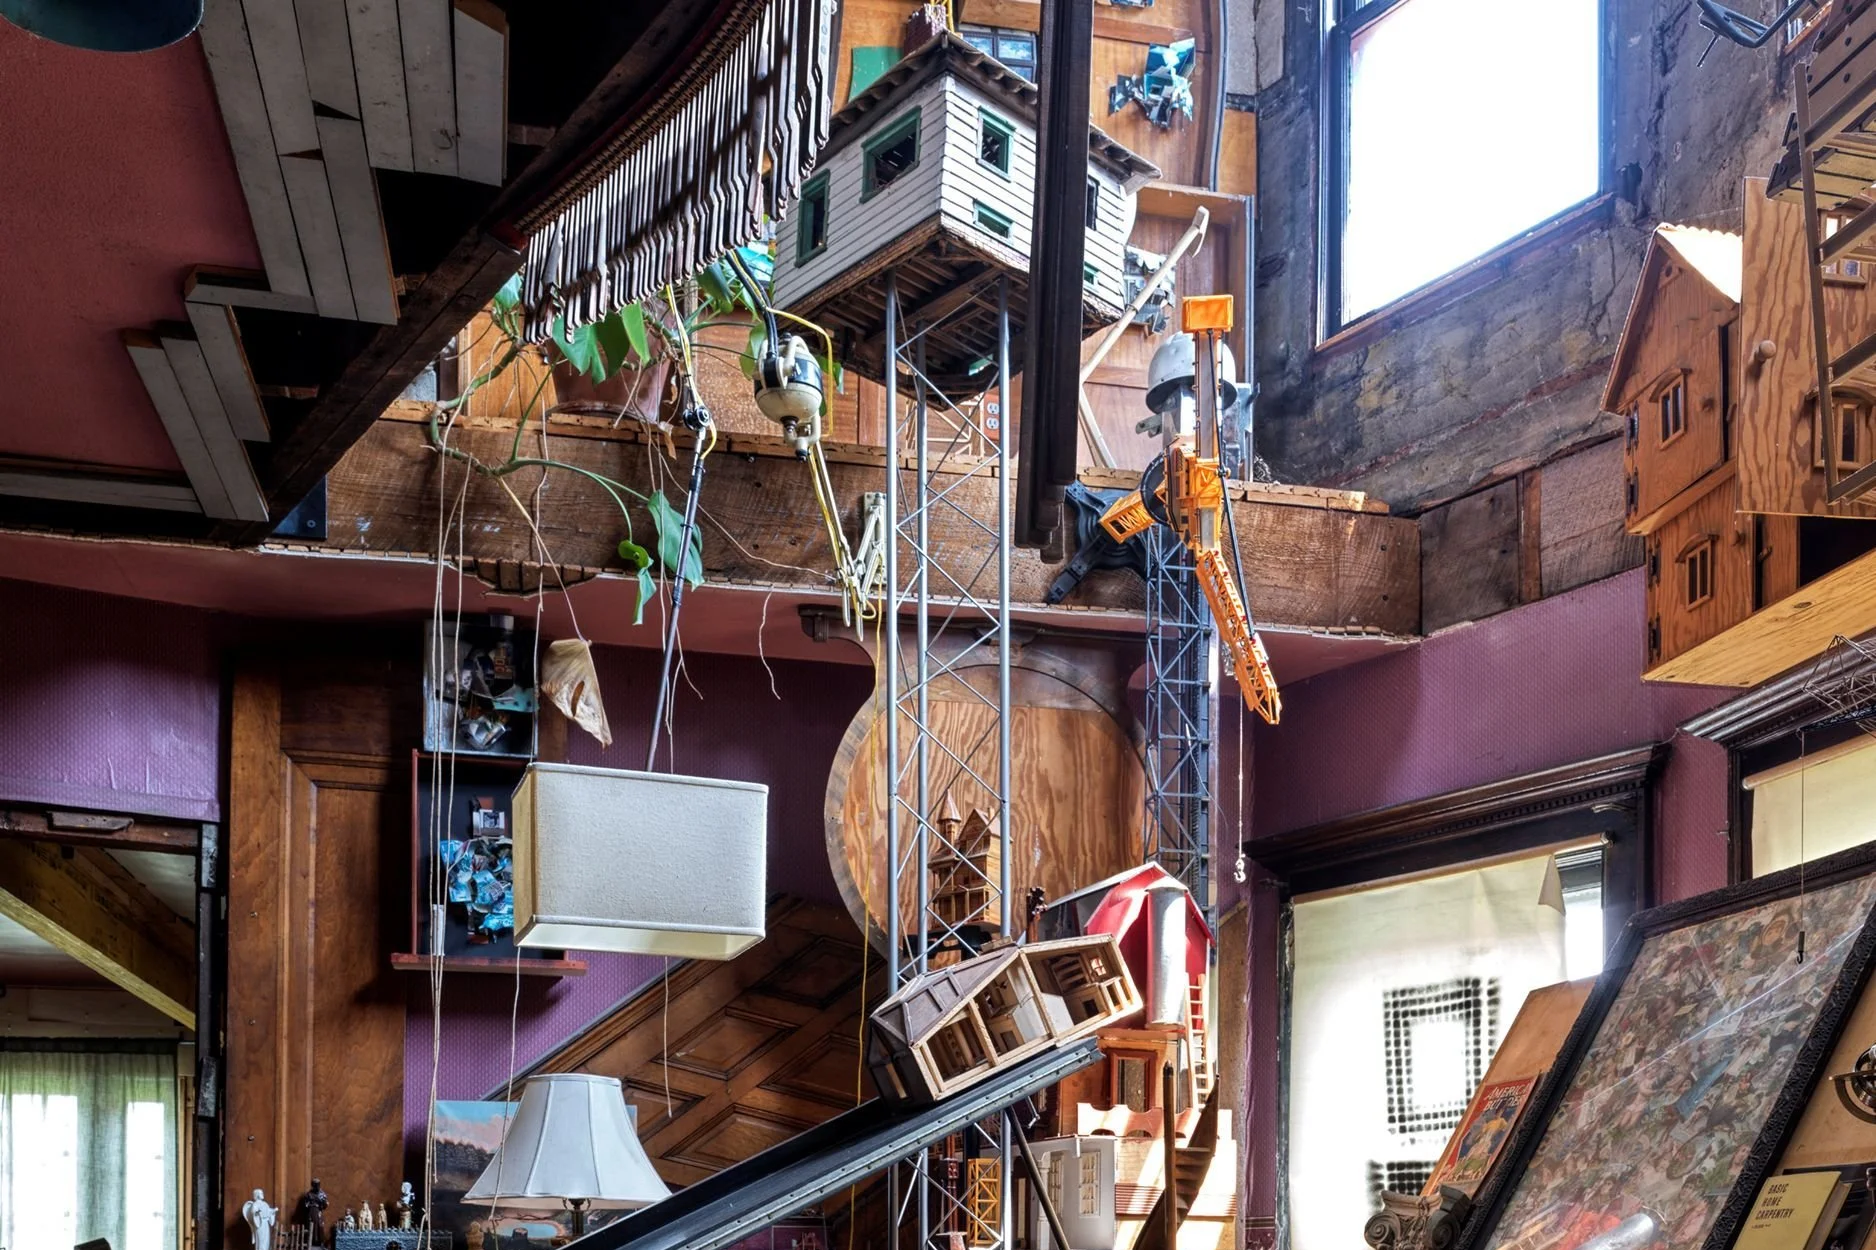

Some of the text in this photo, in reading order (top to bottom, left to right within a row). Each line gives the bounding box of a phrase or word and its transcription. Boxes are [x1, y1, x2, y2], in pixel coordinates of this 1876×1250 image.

[1768, 1183, 1789, 1195] BASIC
[1761, 1196, 1783, 1207] HOME
[1755, 1208, 1795, 1220] CARPENTRY
